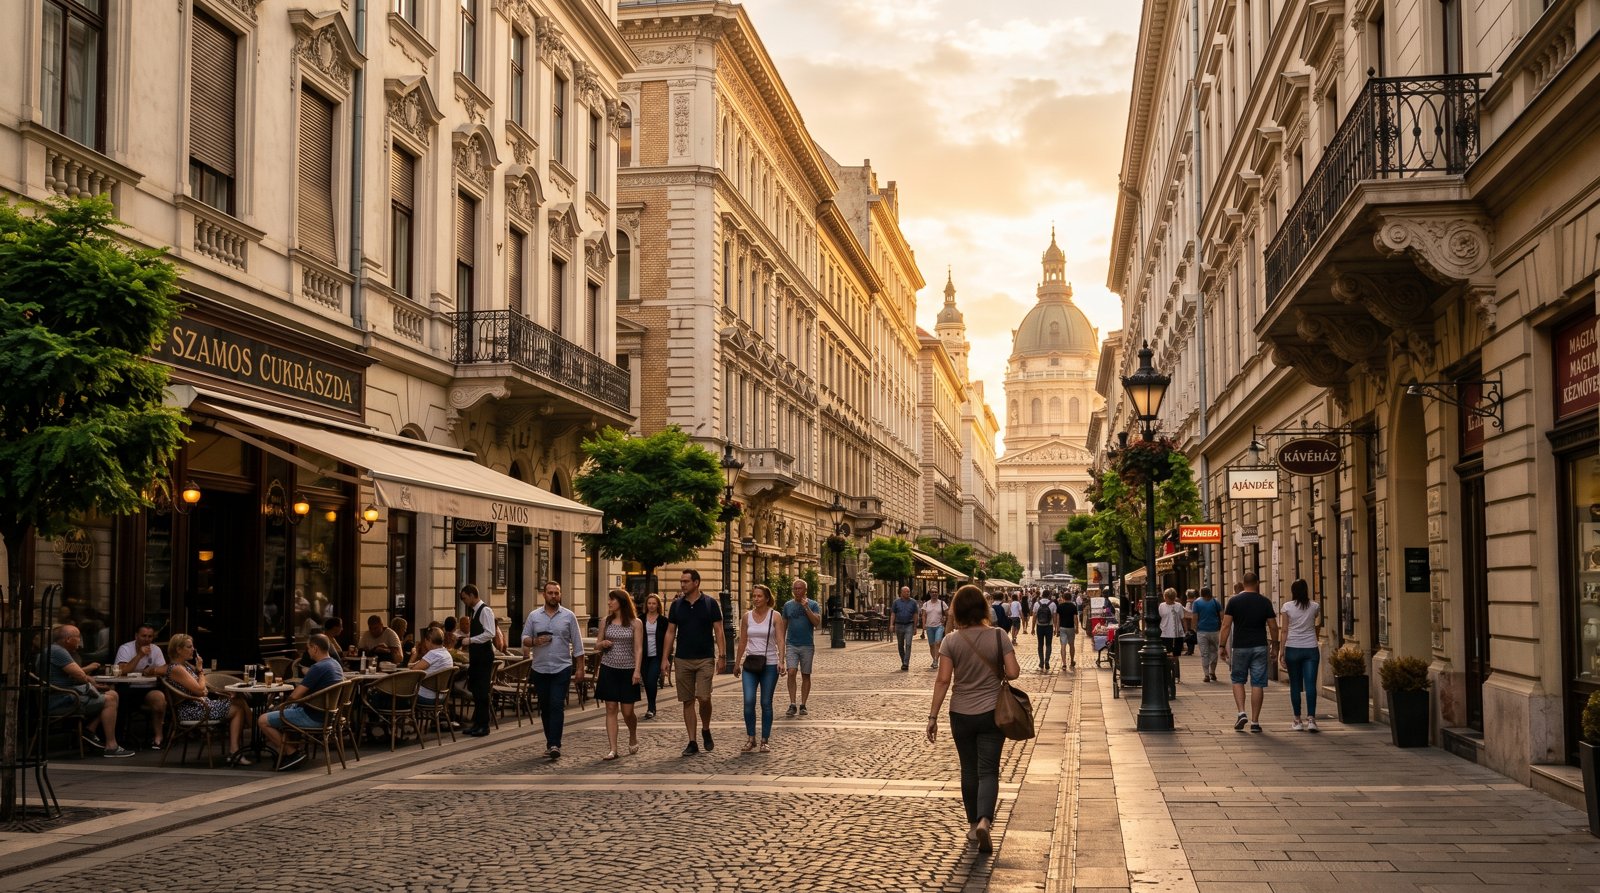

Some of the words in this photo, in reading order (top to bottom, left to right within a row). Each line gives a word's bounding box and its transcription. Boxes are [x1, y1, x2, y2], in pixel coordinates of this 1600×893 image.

[172, 326, 253, 377] SZAMOS
[259, 352, 353, 404] CUKRÁSZDA
[1284, 449, 1337, 462] KÁVÉHÁZ
[1231, 478, 1275, 492] AJÁNDÉK
[491, 502, 529, 524] SZAMOS
